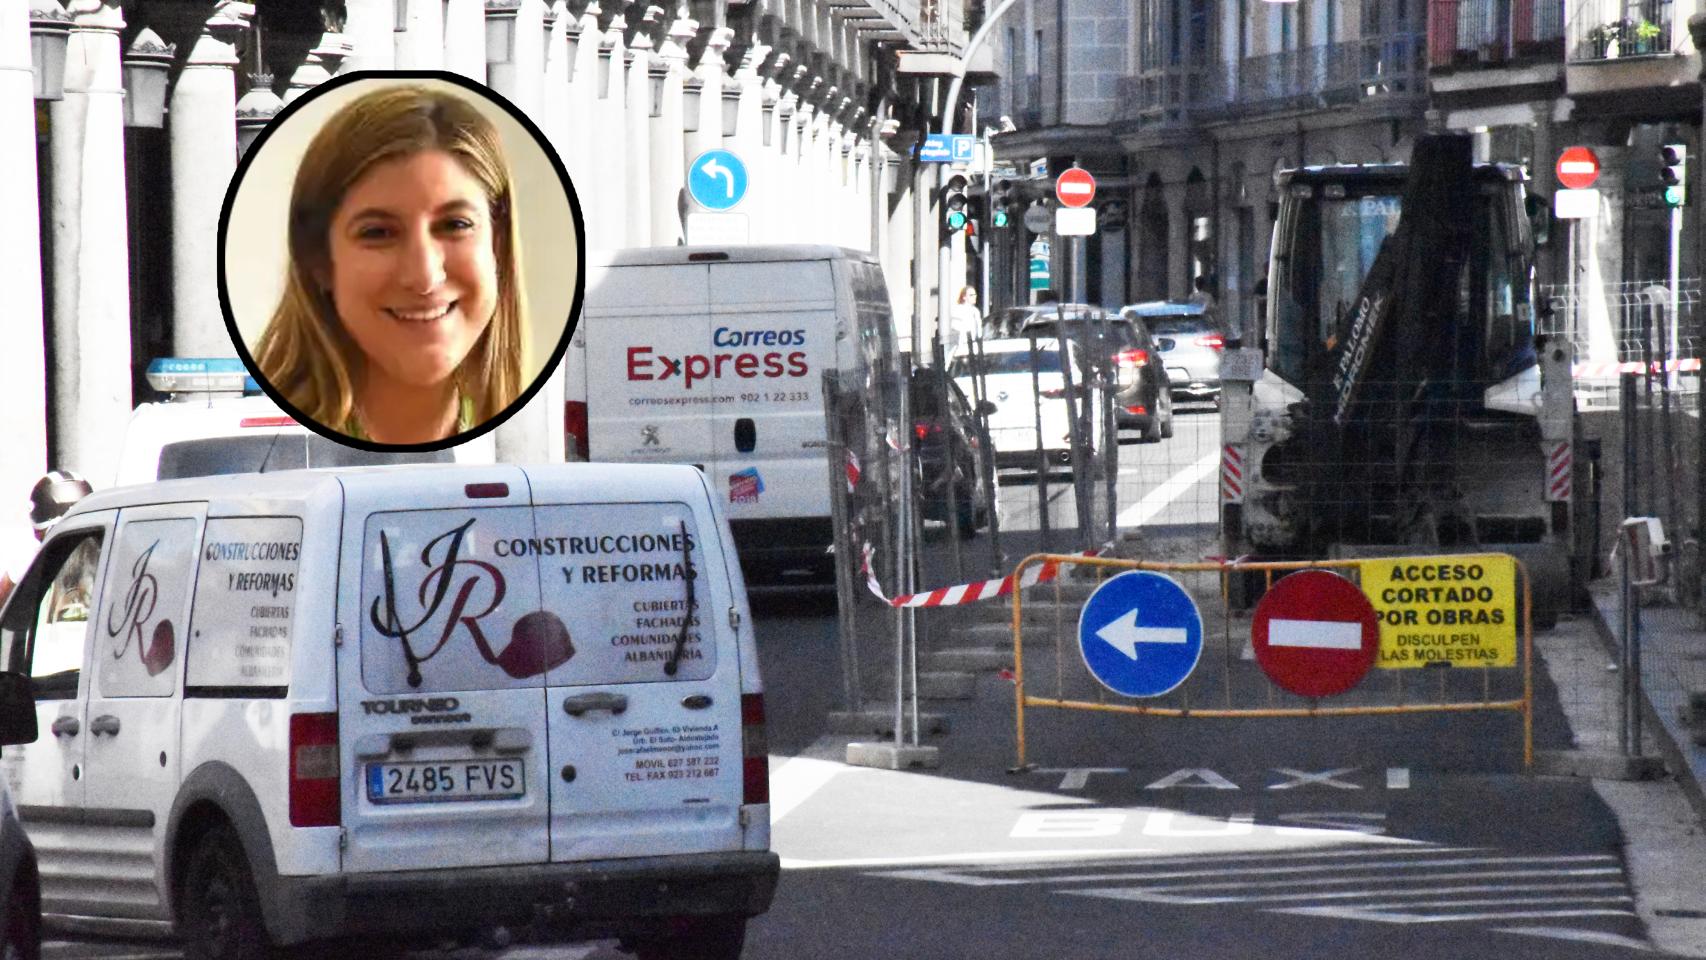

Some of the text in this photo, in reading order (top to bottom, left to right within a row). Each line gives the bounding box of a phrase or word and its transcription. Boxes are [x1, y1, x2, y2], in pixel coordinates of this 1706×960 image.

[713, 327, 806, 347] Correos
[627, 346, 809, 389] Express
[629, 391, 810, 407] correosexpress.com 902 1 22 333
[206, 543, 299, 561] CONSTRUCCIONES
[494, 533, 696, 557] CONSTRUCCIONES
[228, 572, 295, 592] Y REFORMAS
[562, 562, 698, 584] Y REFORMAS
[1391, 564, 1484, 582] ACCESO
[1381, 586, 1494, 604] CORTADO
[633, 600, 700, 613] CUBIERTS
[1426, 608, 1505, 625] OBRAS
[611, 632, 702, 647] COMUNIDAES
[1397, 633, 1480, 647] DISCULPEN
[1381, 648, 1498, 661] LAS MOLESTIAS
[360, 698, 459, 714] TOURNEO
[389, 765, 515, 793] 2485 FVS
[647, 771, 665, 780] FAX
[1031, 767, 1411, 790] TAXI
[1009, 811, 1387, 838] BUS
